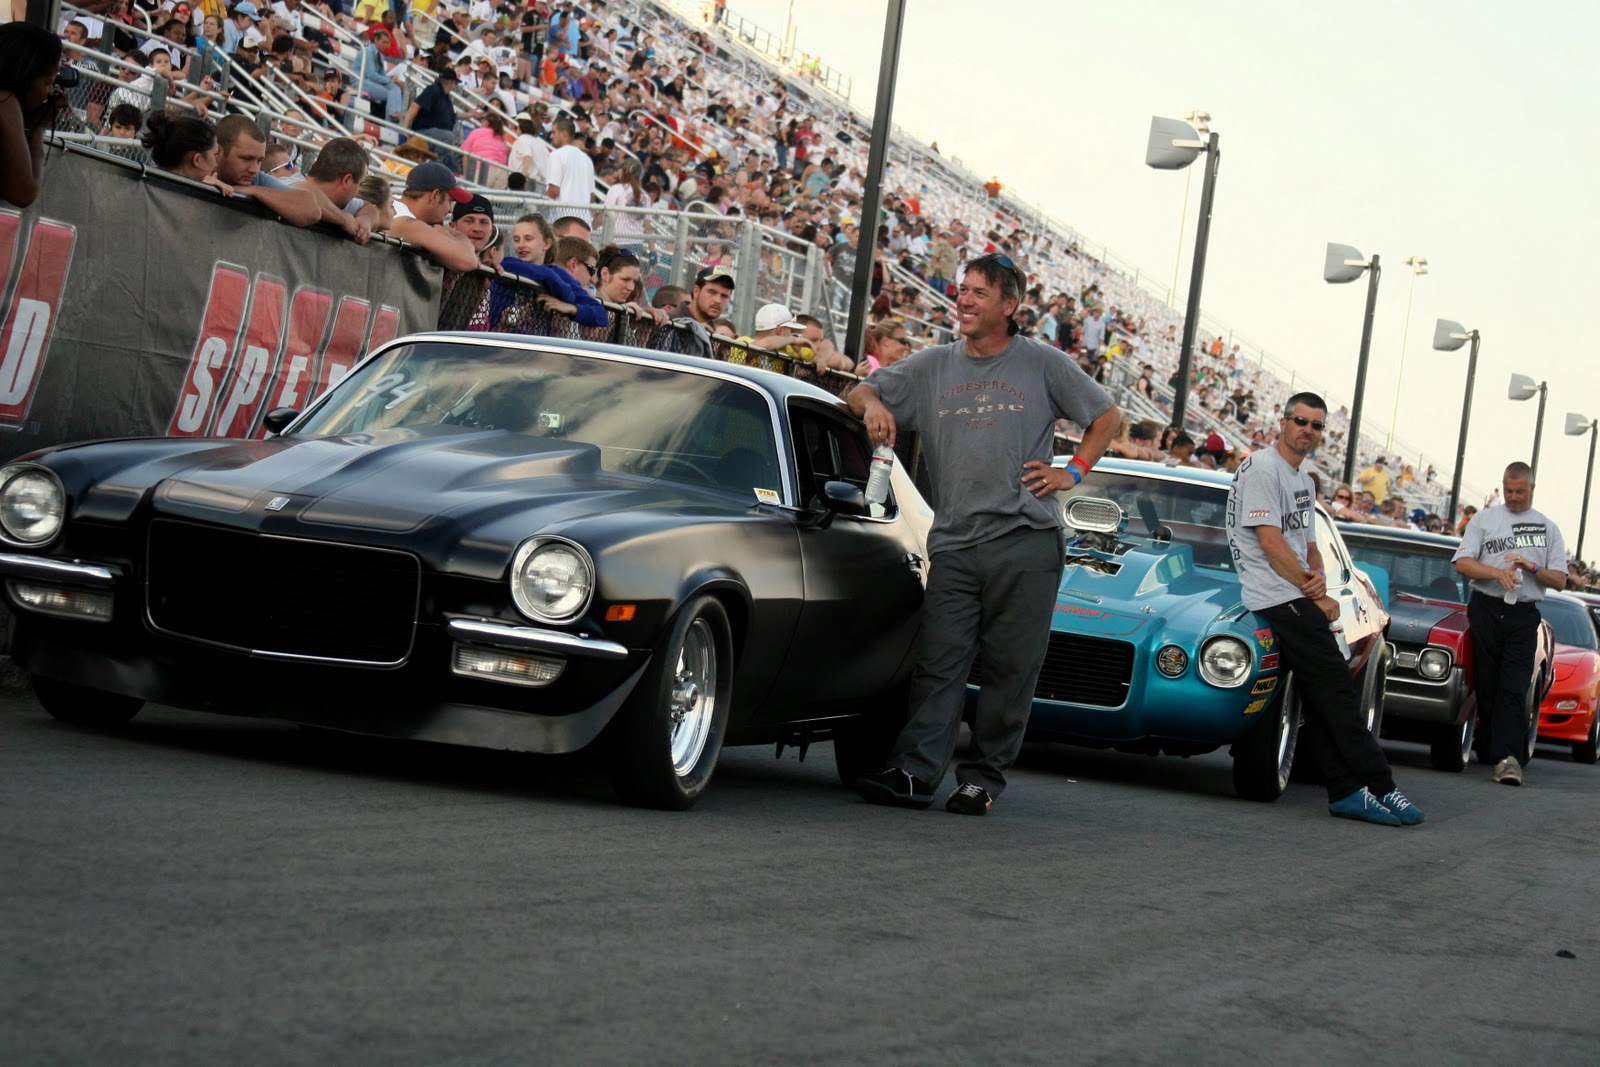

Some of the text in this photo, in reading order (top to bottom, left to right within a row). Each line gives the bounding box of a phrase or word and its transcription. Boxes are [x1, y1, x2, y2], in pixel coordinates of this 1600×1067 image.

[938, 403, 1024, 418] PANIC
[1485, 535, 1547, 554] PINKS ALL OUT
